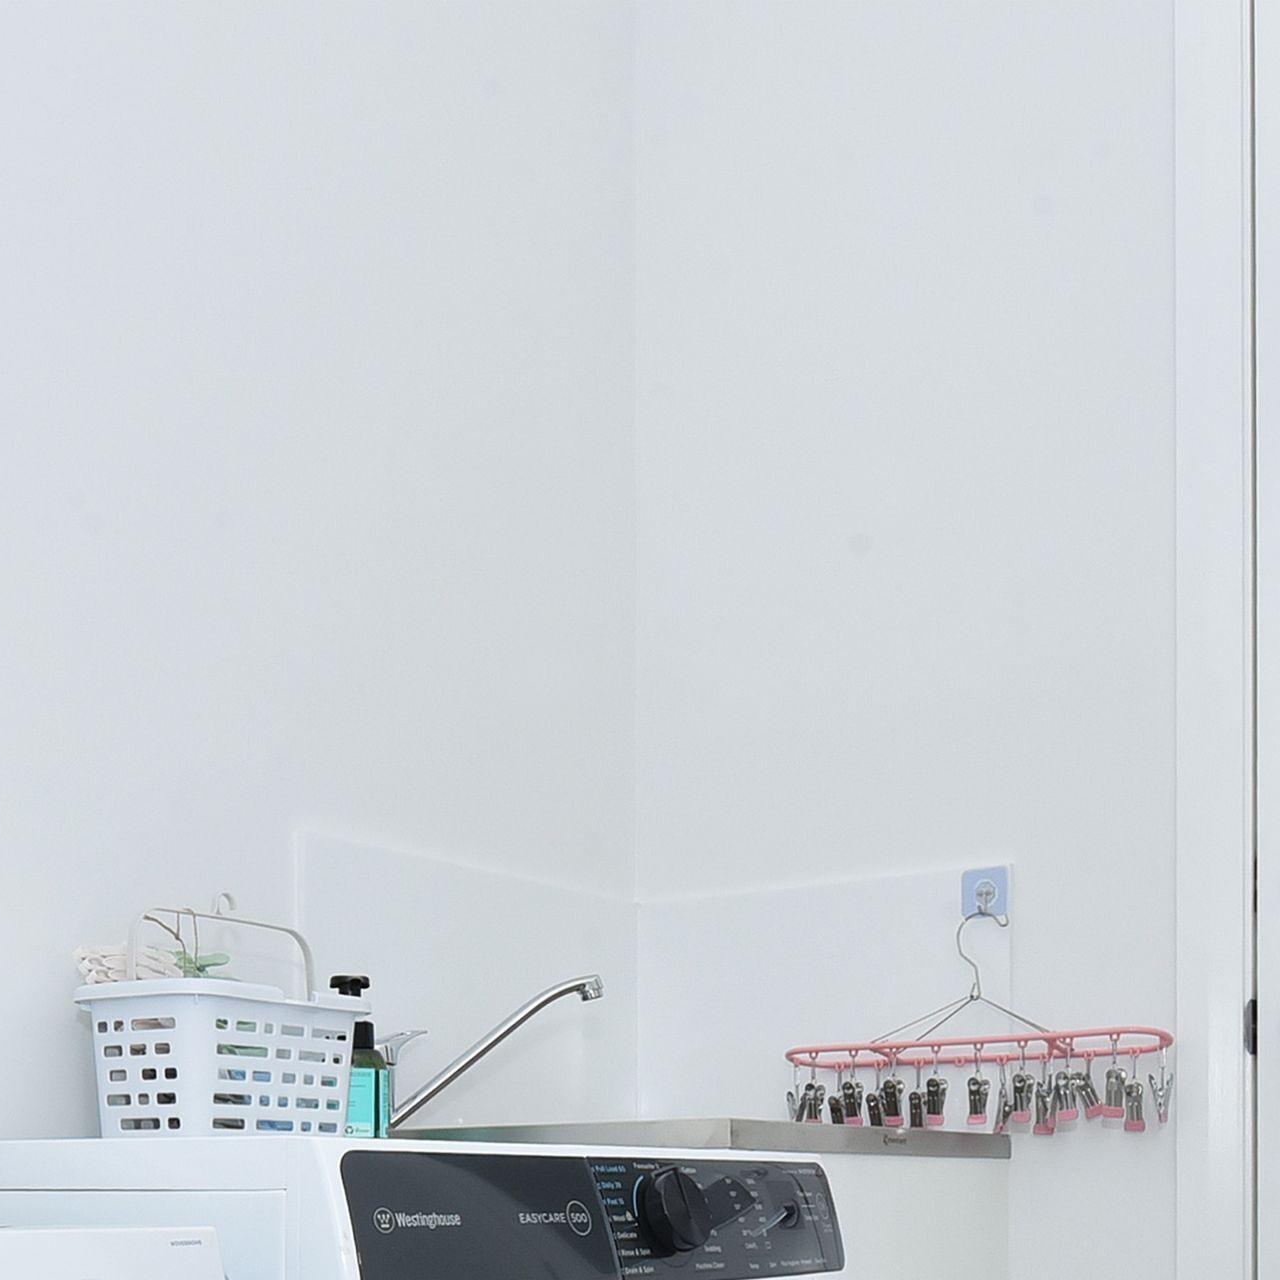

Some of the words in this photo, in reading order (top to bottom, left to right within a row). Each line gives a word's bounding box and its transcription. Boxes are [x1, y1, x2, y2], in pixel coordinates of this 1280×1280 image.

[395, 1211, 462, 1229] Westinghouse
[519, 1213, 566, 1224] EASYCARE
[570, 1213, 587, 1223] 500
